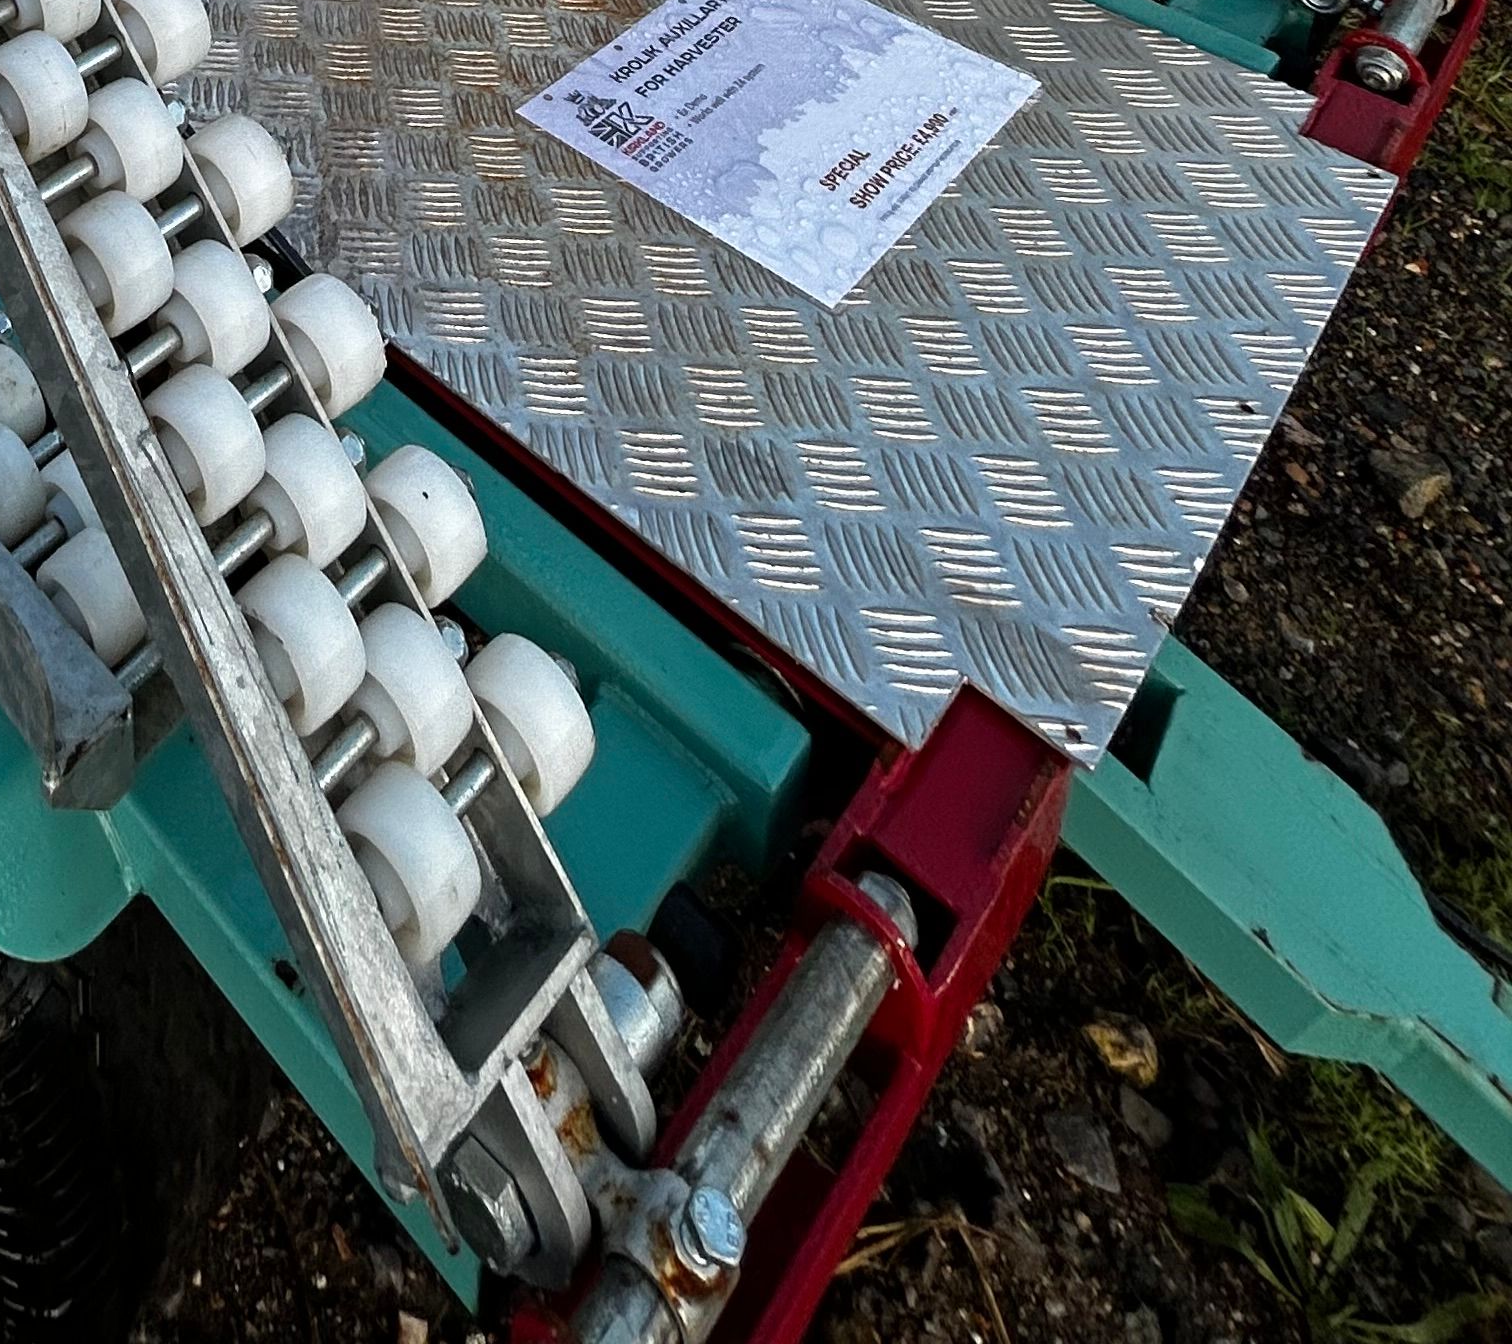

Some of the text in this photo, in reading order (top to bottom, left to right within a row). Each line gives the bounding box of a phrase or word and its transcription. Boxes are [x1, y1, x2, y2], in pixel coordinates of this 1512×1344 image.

[608, 44, 664, 84] KROLIK
[634, 15, 743, 98] FOR HARVESTER
[620, 120, 666, 157] KIRKLAND
[637, 130, 685, 168] BRITISH
[649, 137, 694, 173] GROWERS
[819, 148, 872, 192] SPECIAL
[848, 172, 890, 210] SHOW
[879, 142, 923, 179] PRICE:
